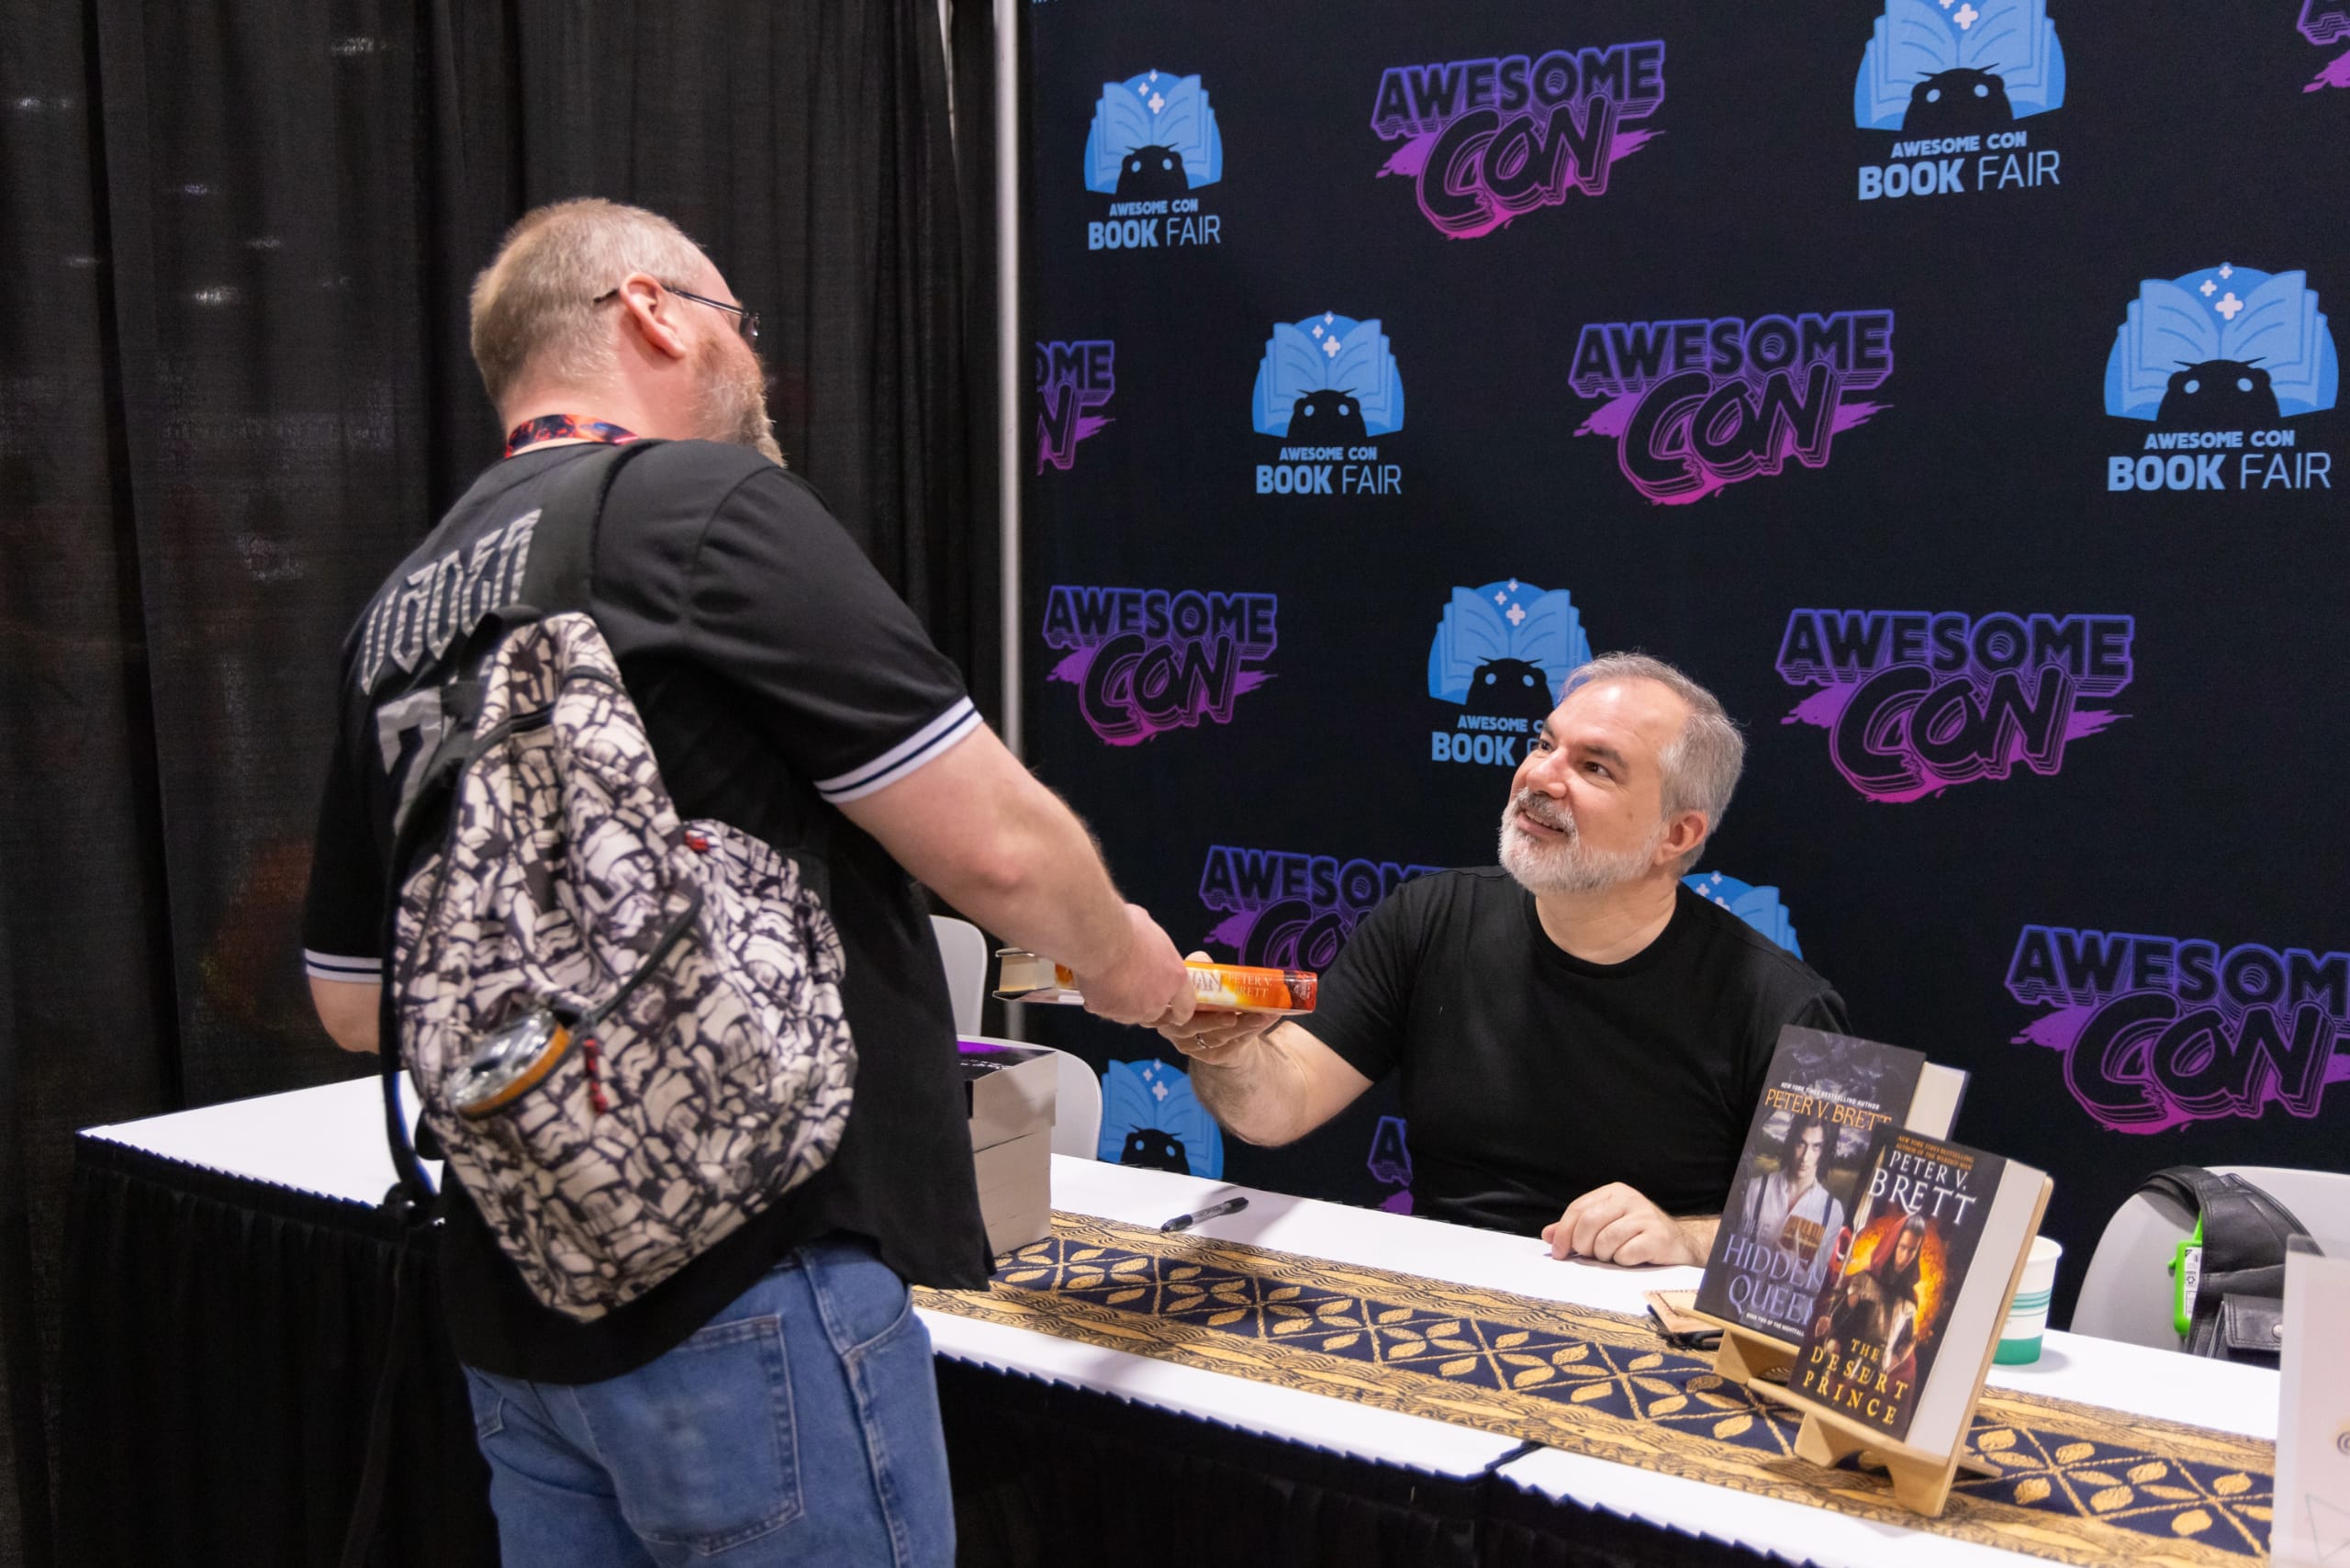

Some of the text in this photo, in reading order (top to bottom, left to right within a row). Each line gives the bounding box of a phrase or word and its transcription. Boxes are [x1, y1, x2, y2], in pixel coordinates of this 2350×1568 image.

[1371, 40, 1665, 140] AWESOME
[1416, 93, 1617, 233] CON
[1891, 130, 2028, 159] AWESOME CON
[1858, 150, 2062, 201] BOOK FAIR
[1088, 214, 1221, 250] BOOK FAIR
[1109, 197, 1199, 217] AWESOME CON
[1569, 309, 1894, 398] AWESOME
[1279, 446, 1378, 461] AWESOME CON
[1618, 361, 1845, 498] CON
[2143, 429, 2295, 450] AWESOME CON
[1256, 465, 1403, 495] BOOK FAIR
[2107, 452, 2332, 492] BOOK FAIR
[1043, 586, 1278, 660] AWESOME
[1775, 609, 2135, 697] AWESOME
[1080, 634, 1241, 738] CON
[1431, 731, 1516, 767] BOOK
[1457, 714, 1528, 733] AWESOME
[1830, 662, 2077, 796] CON
[1199, 846, 1446, 913] AWESO
[1227, 972, 1262, 987] PETER
[2005, 924, 2350, 1033] AWESOM
[2064, 989, 2337, 1127] CON
[1764, 1088, 1814, 1116] PETER
[1817, 1099, 1829, 1120] V.
[1781, 1081, 1880, 1110] NEW YORK TIMES BESTSELLING AUTHOR
[1889, 1149, 1969, 1191] PETER V.
[1868, 1167, 1977, 1226] BRETT
[1722, 1233, 1829, 1293] HIDDEN
[1810, 1346, 1908, 1400] DESERT
[1851, 1338, 1881, 1362] THE
[1803, 1370, 1897, 1425] PRINCE
